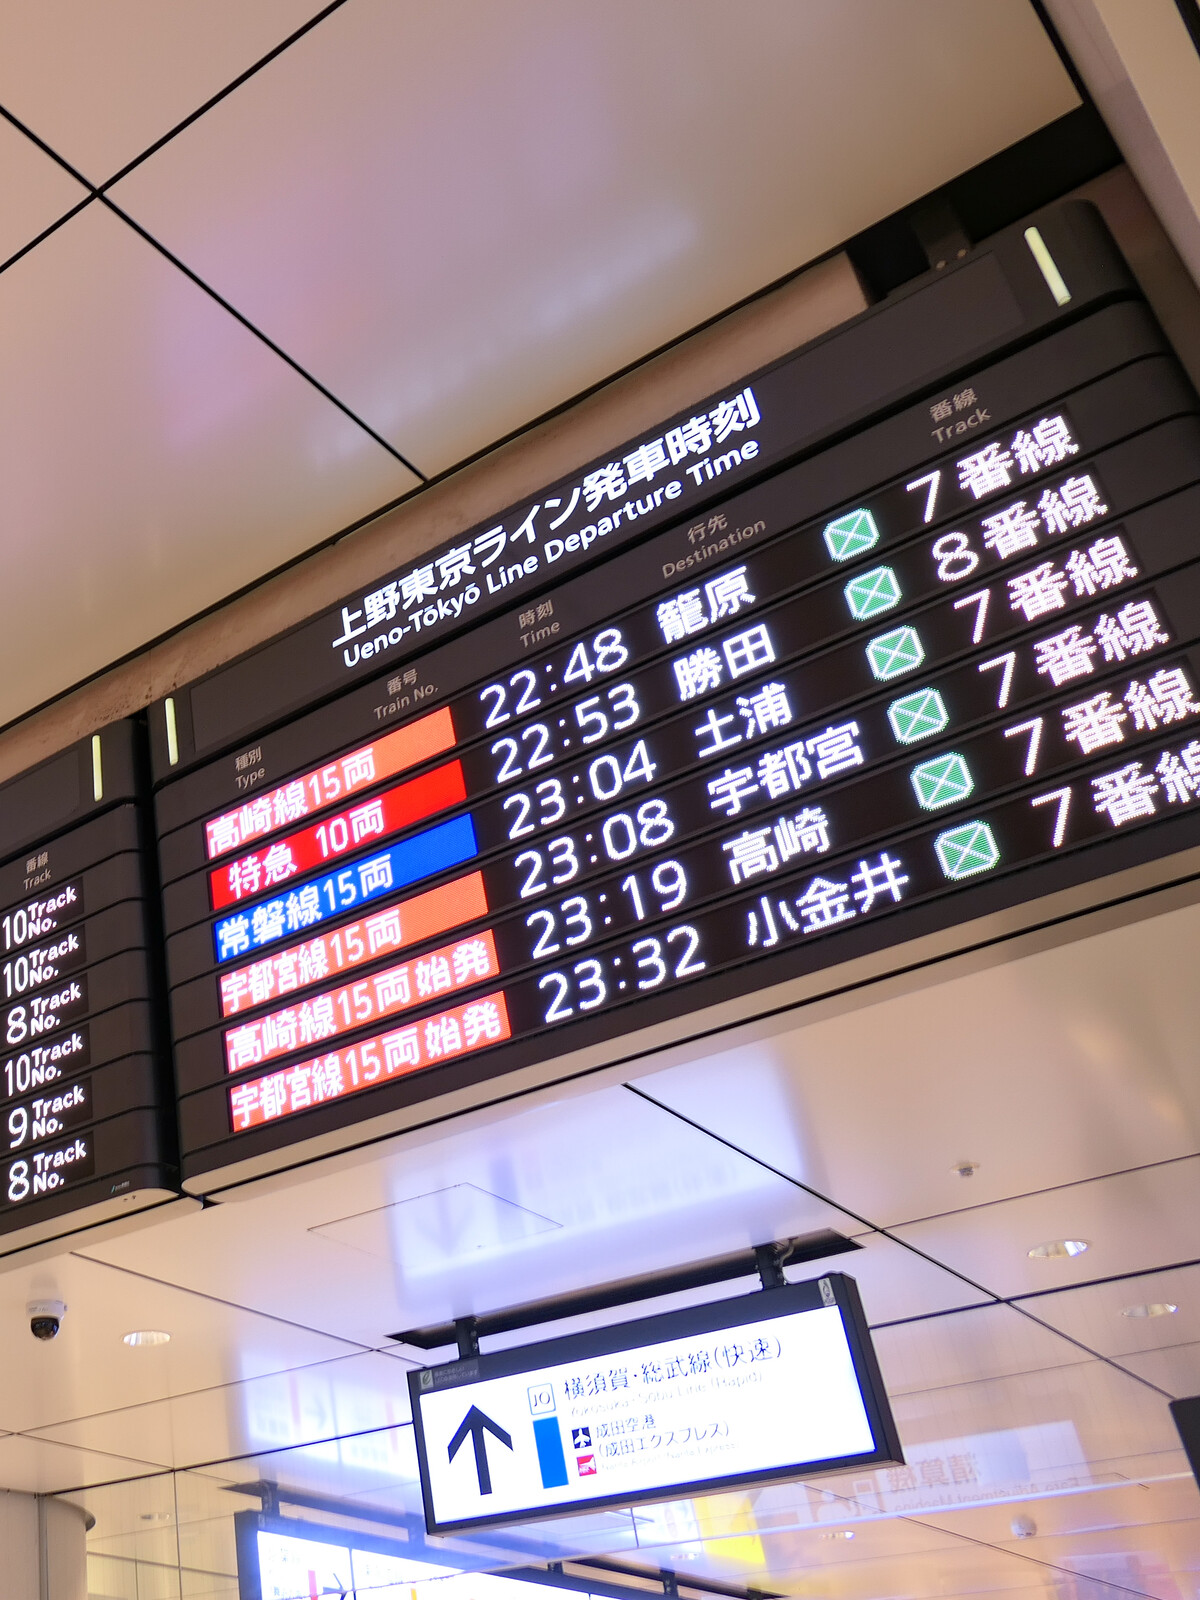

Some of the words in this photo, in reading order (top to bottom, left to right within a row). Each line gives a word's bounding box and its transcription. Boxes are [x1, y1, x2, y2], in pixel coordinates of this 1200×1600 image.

[929, 388, 978, 424] 番線
[930, 407, 992, 444] Track
[332, 387, 762, 649] 上野東京ライン発車時刻
[687, 513, 728, 544] 行先
[343, 582, 481, 668] Ueno-Tōkyō
[487, 554, 539, 597] Line
[543, 481, 683, 565] Departure
[686, 438, 760, 488] Time
[662, 517, 767, 580] Destination
[518, 600, 554, 629] 時刻
[480, 628, 629, 730] 22:48
[656, 566, 755, 644] 籠原
[520, 618, 560, 648] Time
[386, 668, 418, 697] 番号
[374, 691, 411, 721] Train
[410, 682, 439, 707] No.
[228, 845, 298, 900] 特急
[315, 800, 385, 858] 10両
[491, 682, 642, 784] 22:53
[672, 624, 776, 701] 勝田
[234, 746, 263, 774] 種別
[235, 765, 266, 791] Type
[503, 739, 657, 840] 23:04
[694, 682, 794, 758] 土浦
[514, 798, 675, 899] 23:08
[707, 721, 864, 817] 宇都宮
[23, 868, 52, 892] Track
[26, 851, 49, 874] 番線
[526, 859, 688, 960] 23:19
[722, 806, 830, 885] 高崎
[28, 886, 78, 922] Track
[2, 909, 28, 950] 10
[28, 917, 58, 940] No.
[539, 923, 707, 1025] 23:32
[747, 852, 910, 947] 小金井
[29, 933, 80, 969] Track
[3, 956, 29, 998] 10
[29, 965, 59, 988] No.
[30, 982, 82, 1017] Track
[6, 1005, 28, 1044] 8
[30, 1013, 61, 1037] No.
[31, 1033, 84, 1068] Track
[4, 1054, 31, 1097] 10
[31, 1065, 62, 1088] No.
[32, 1085, 85, 1120] Track
[8, 1106, 28, 1149] 9
[32, 1117, 64, 1140] No.
[33, 1139, 87, 1175] Track
[8, 1159, 30, 1202] 8
[33, 1171, 65, 1195] No.
[533, 1391, 551, 1408] JO
[596, 1413, 657, 1439] 成田空港
